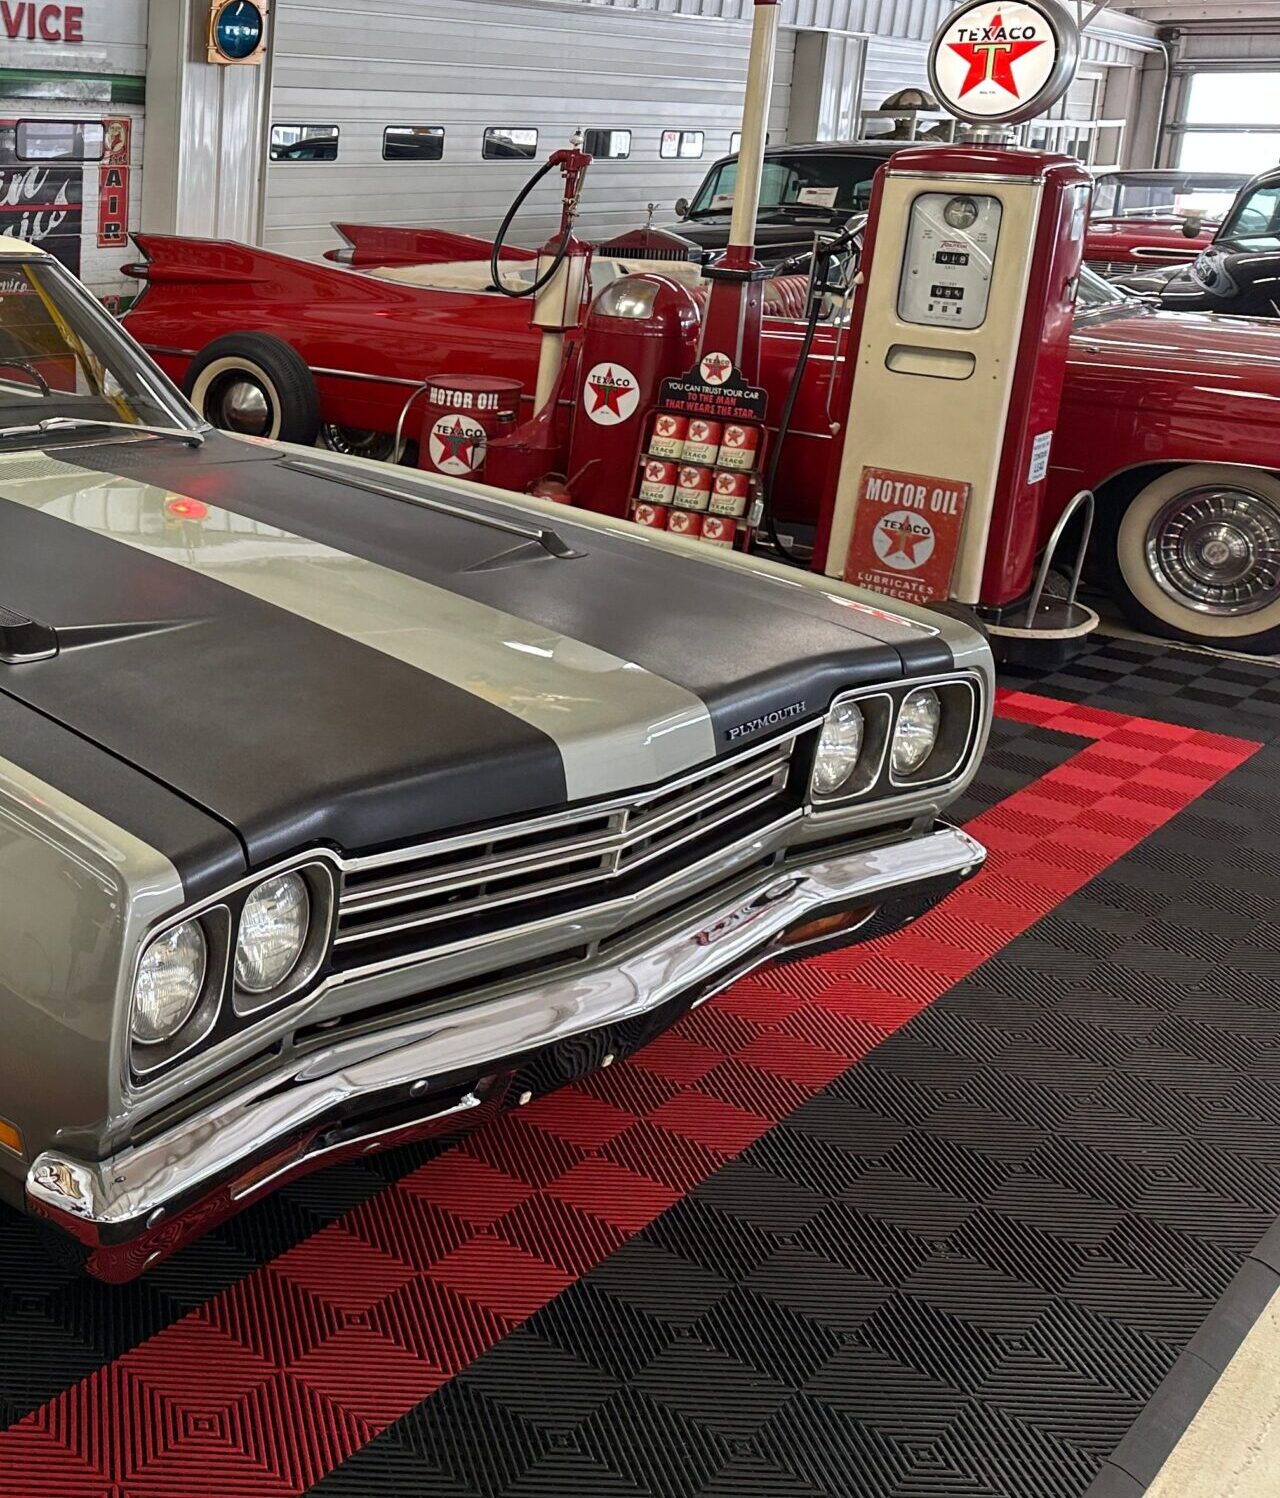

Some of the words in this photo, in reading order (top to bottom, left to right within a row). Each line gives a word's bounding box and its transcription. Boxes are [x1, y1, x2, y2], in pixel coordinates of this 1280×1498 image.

[957, 26, 1036, 42] TEXACO
[104, 169, 122, 239] AIR
[591, 374, 630, 387] TEXACO
[429, 387, 473, 408] MOTOR
[477, 393, 499, 410] OIL
[668, 382, 684, 391] YOU
[684, 384, 701, 392] CAN
[702, 386, 721, 395] TRUST
[723, 389, 744, 397] YOUR
[743, 392, 760, 400] CAR
[687, 392, 698, 400] TO
[700, 394, 714, 403] THE
[716, 397, 737, 406] MAN
[665, 399, 685, 408] THAT
[686, 401, 715, 414] WEARS
[717, 405, 732, 416] THE
[436, 424, 484, 438] TEXACO
[865, 477, 927, 510] MOTOR
[930, 488, 958, 515] OIL
[883, 519, 931, 535] TEXACO
[857, 571, 934, 595] LUBRICATES
[859, 582, 929, 604] PERFECTLY
[728, 701, 807, 740] PLYMOUTH
